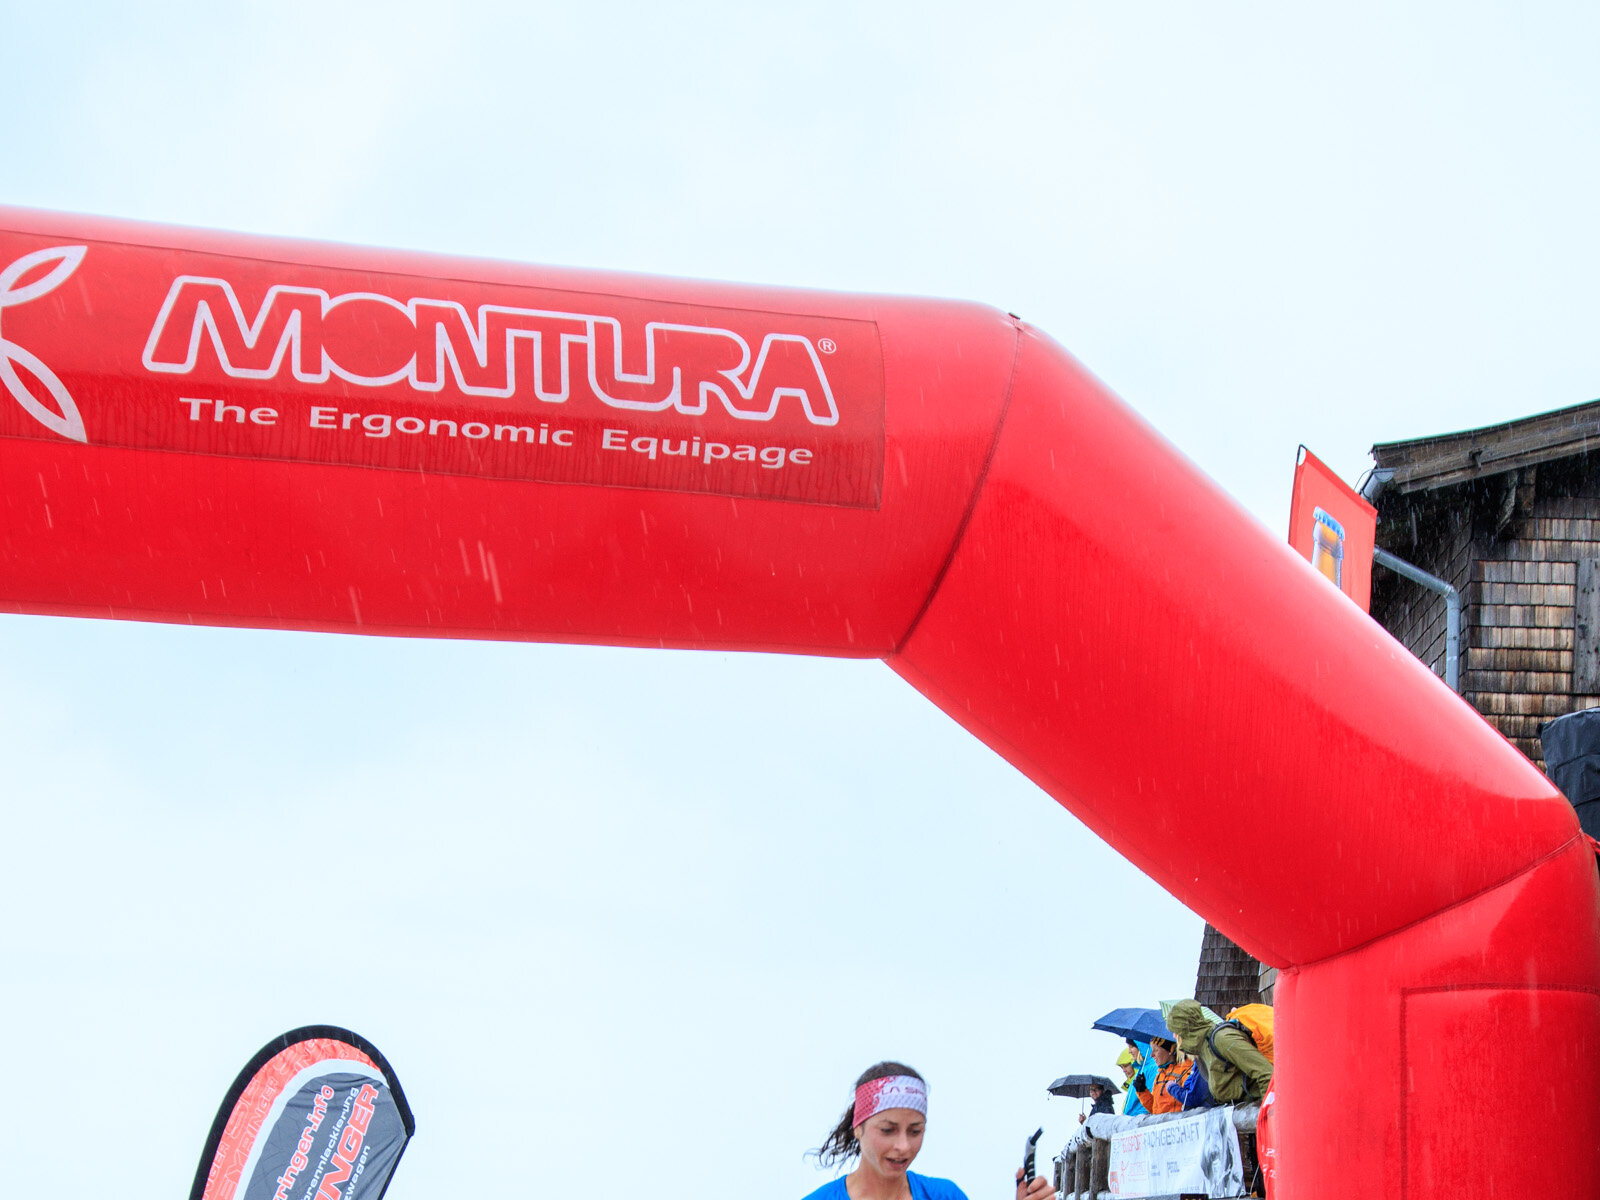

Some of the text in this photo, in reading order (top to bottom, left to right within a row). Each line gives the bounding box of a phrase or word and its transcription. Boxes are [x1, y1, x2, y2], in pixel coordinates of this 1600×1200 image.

[179, 397, 813, 469] The Ergonomic Equipage
